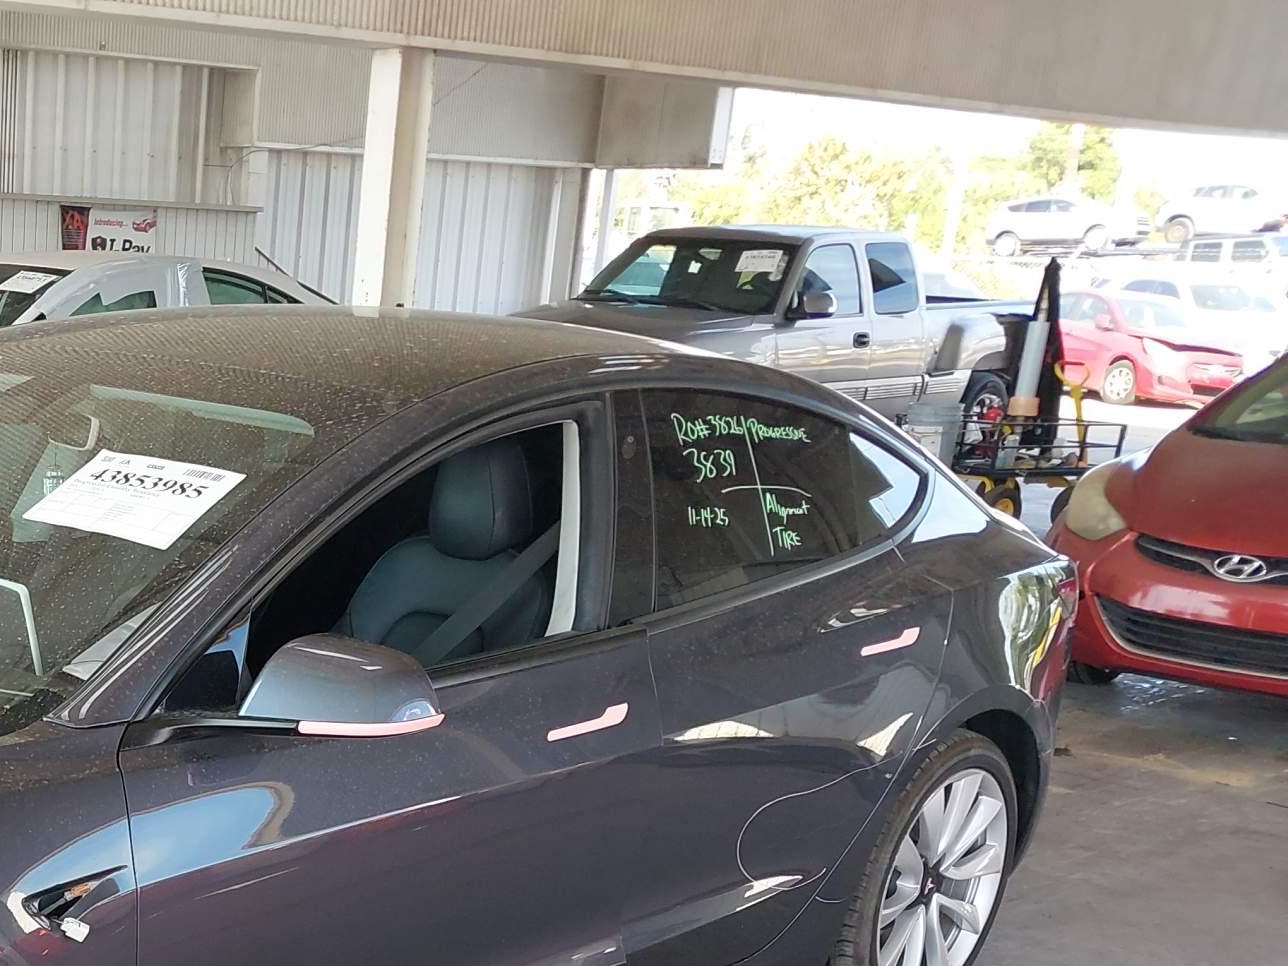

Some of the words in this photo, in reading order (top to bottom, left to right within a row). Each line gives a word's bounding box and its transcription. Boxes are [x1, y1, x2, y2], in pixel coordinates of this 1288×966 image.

[682, 447, 737, 484] 3839
[90, 468, 209, 499] 43853985
[687, 505, 729, 528] 11-14-25
[772, 526, 802, 551] TIRE
